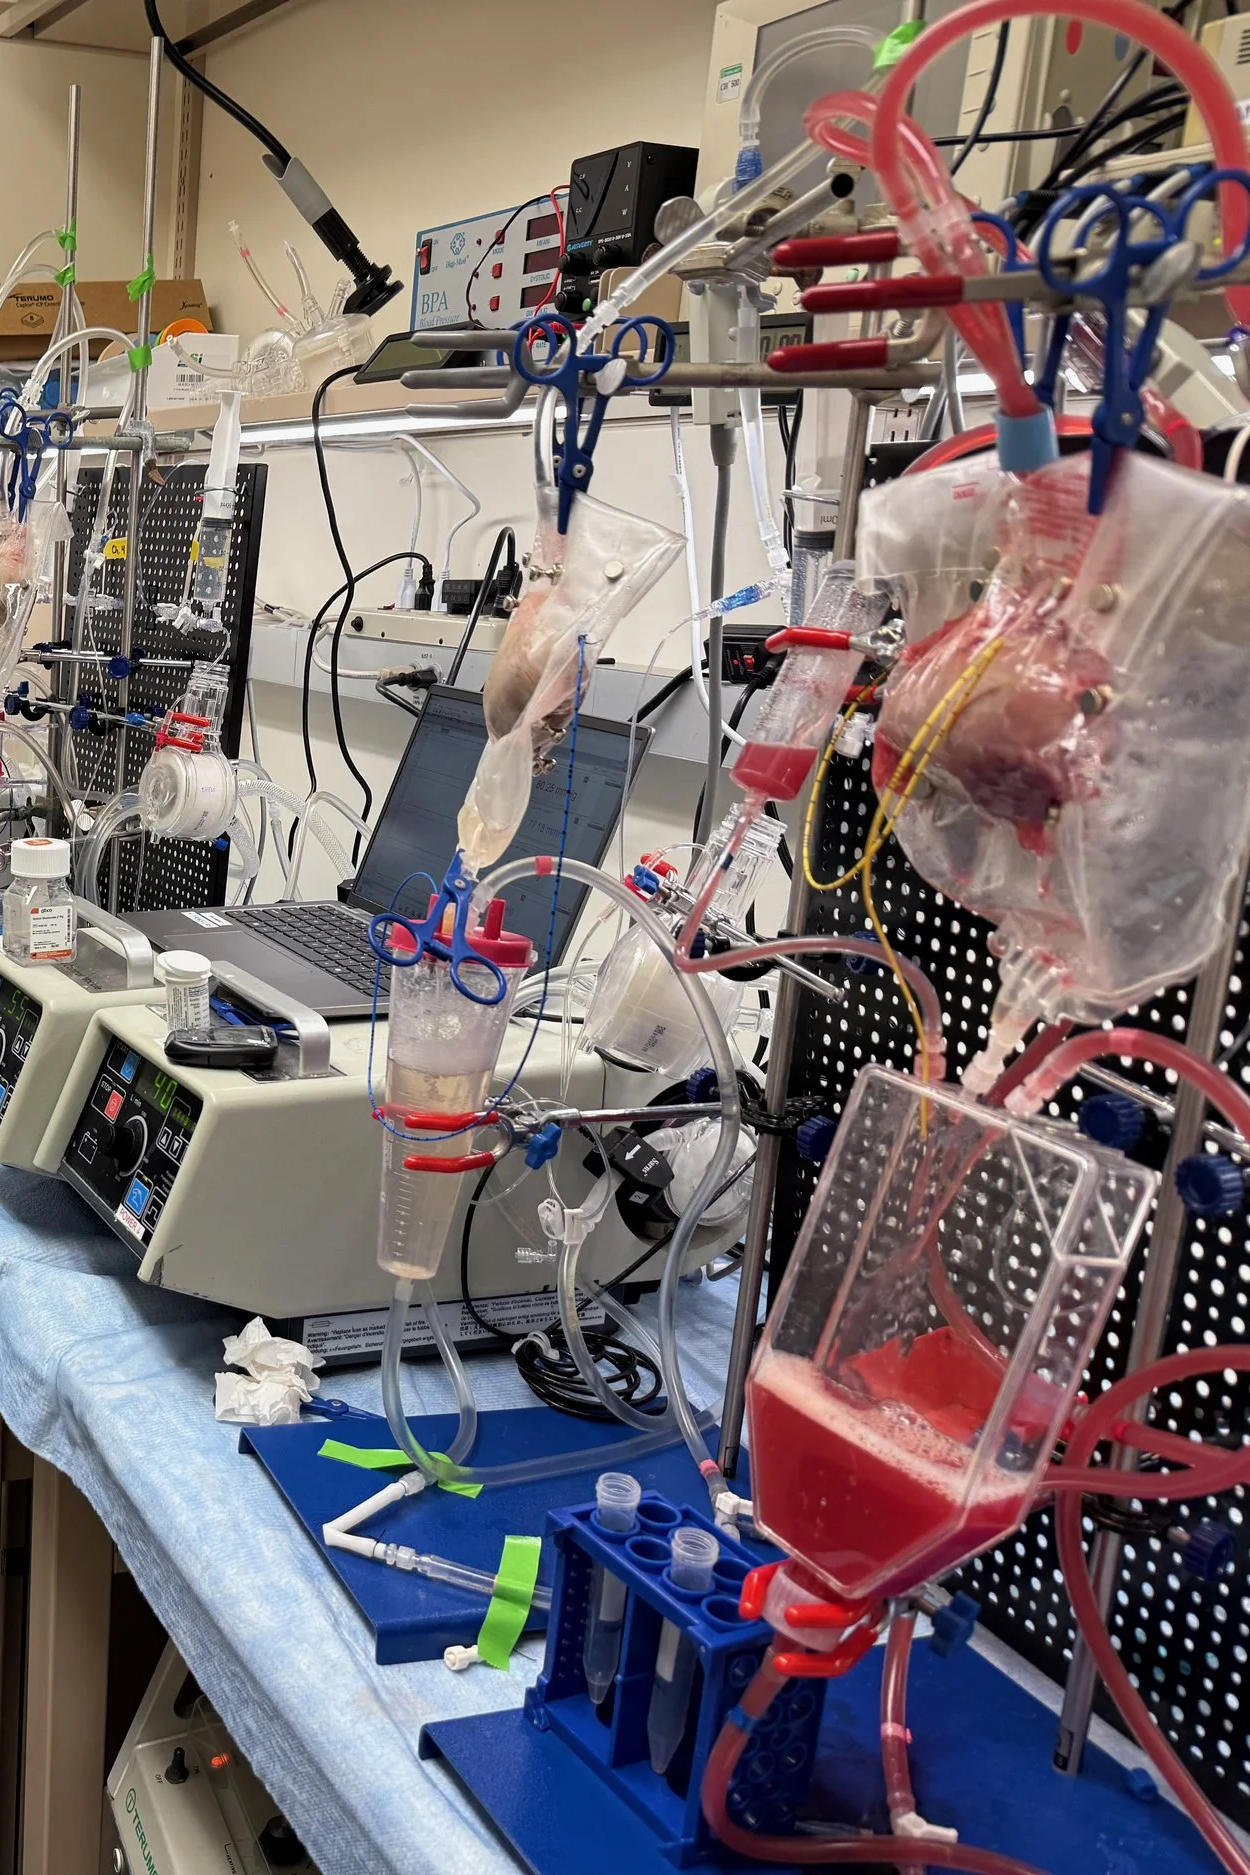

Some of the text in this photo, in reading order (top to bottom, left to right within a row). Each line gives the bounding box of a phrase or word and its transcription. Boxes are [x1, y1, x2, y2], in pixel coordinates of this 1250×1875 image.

[492, 246, 505, 255] MODE
[421, 290, 449, 315] BPA
[100, 1080, 113, 1093] STOP
[118, 1209, 139, 1233] POWER
[154, 1774, 164, 1785] OFF
